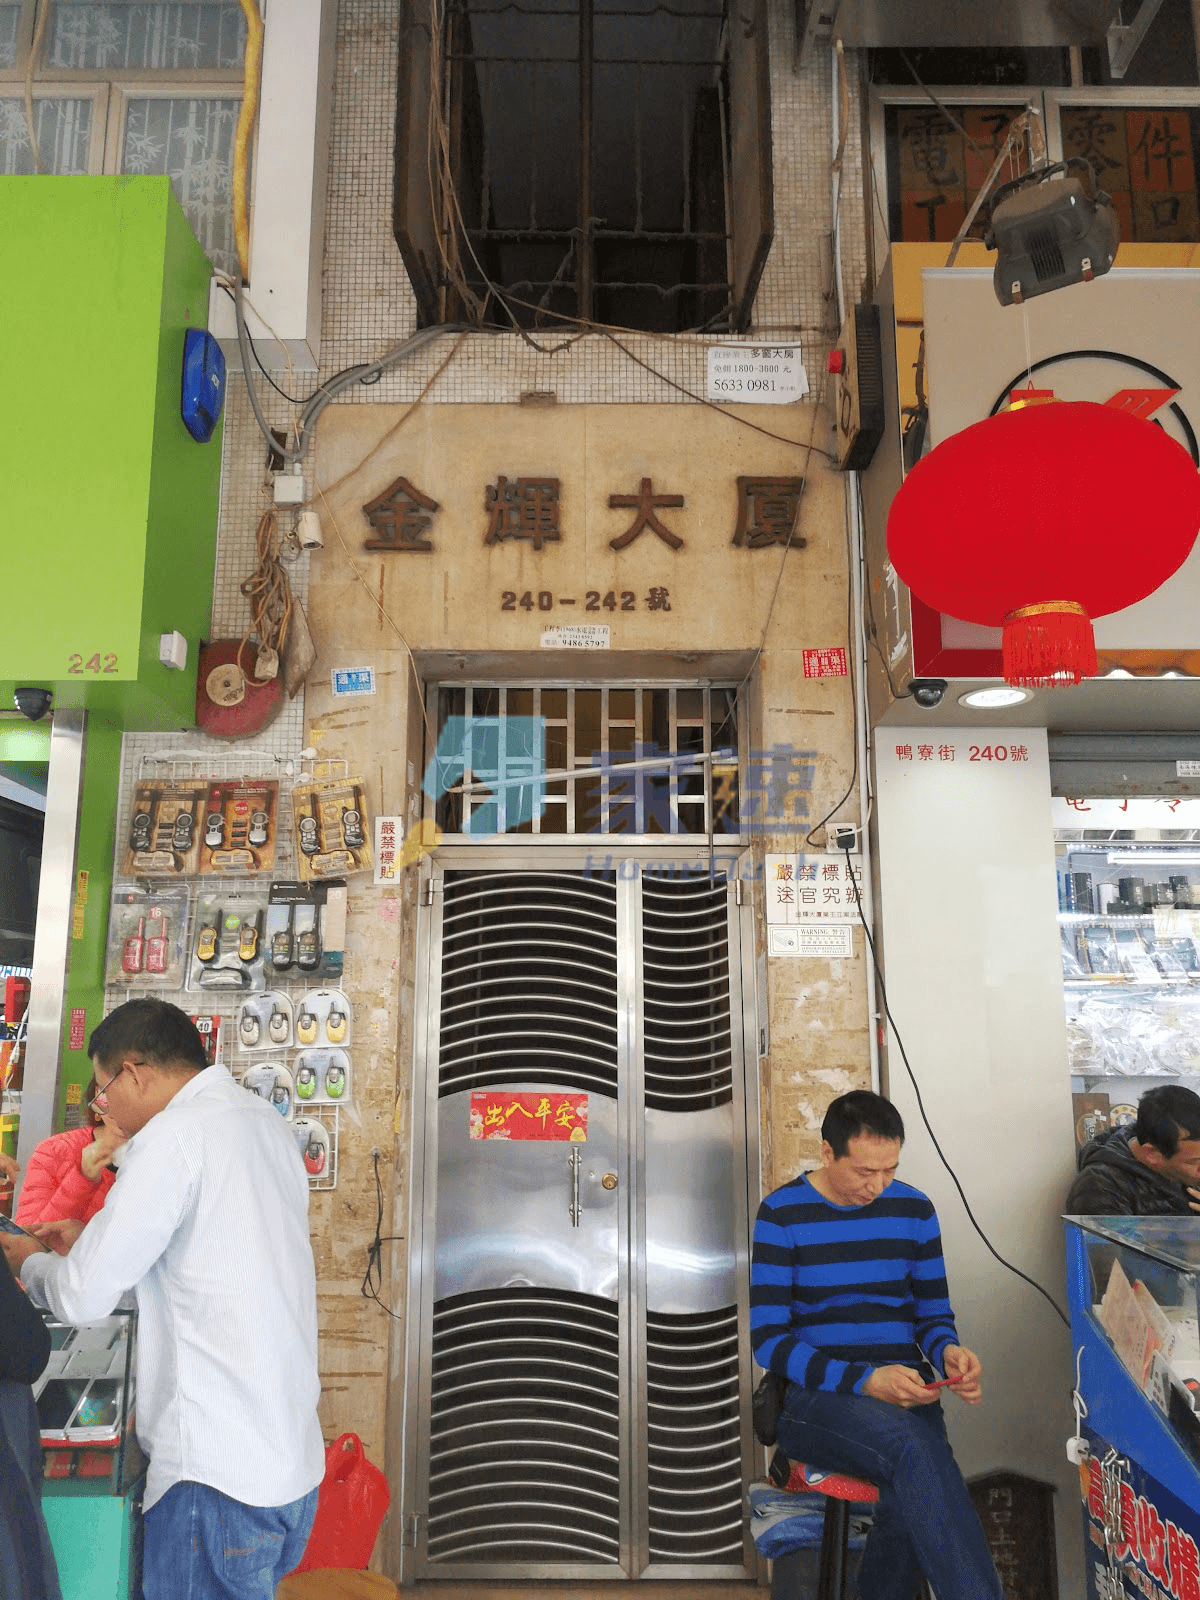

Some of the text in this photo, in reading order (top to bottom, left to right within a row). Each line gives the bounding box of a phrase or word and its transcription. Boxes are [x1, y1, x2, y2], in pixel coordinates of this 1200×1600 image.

[734, 364, 779, 373] 1800-3600
[713, 379, 743, 391] 5633
[747, 379, 776, 391] 0981
[361, 475, 807, 552] 金輝大廈
[562, 639, 583, 647] 9486
[584, 640, 605, 648] 5797
[67, 652, 119, 674] 242
[895, 744, 1029, 761] 鴨寮街 240號
[379, 821, 396, 879] 嚴禁標貼
[776, 864, 863, 881] 嚴禁標貼
[777, 886, 864, 904] 送官究辦
[484, 1097, 576, 1130] 出入平安
